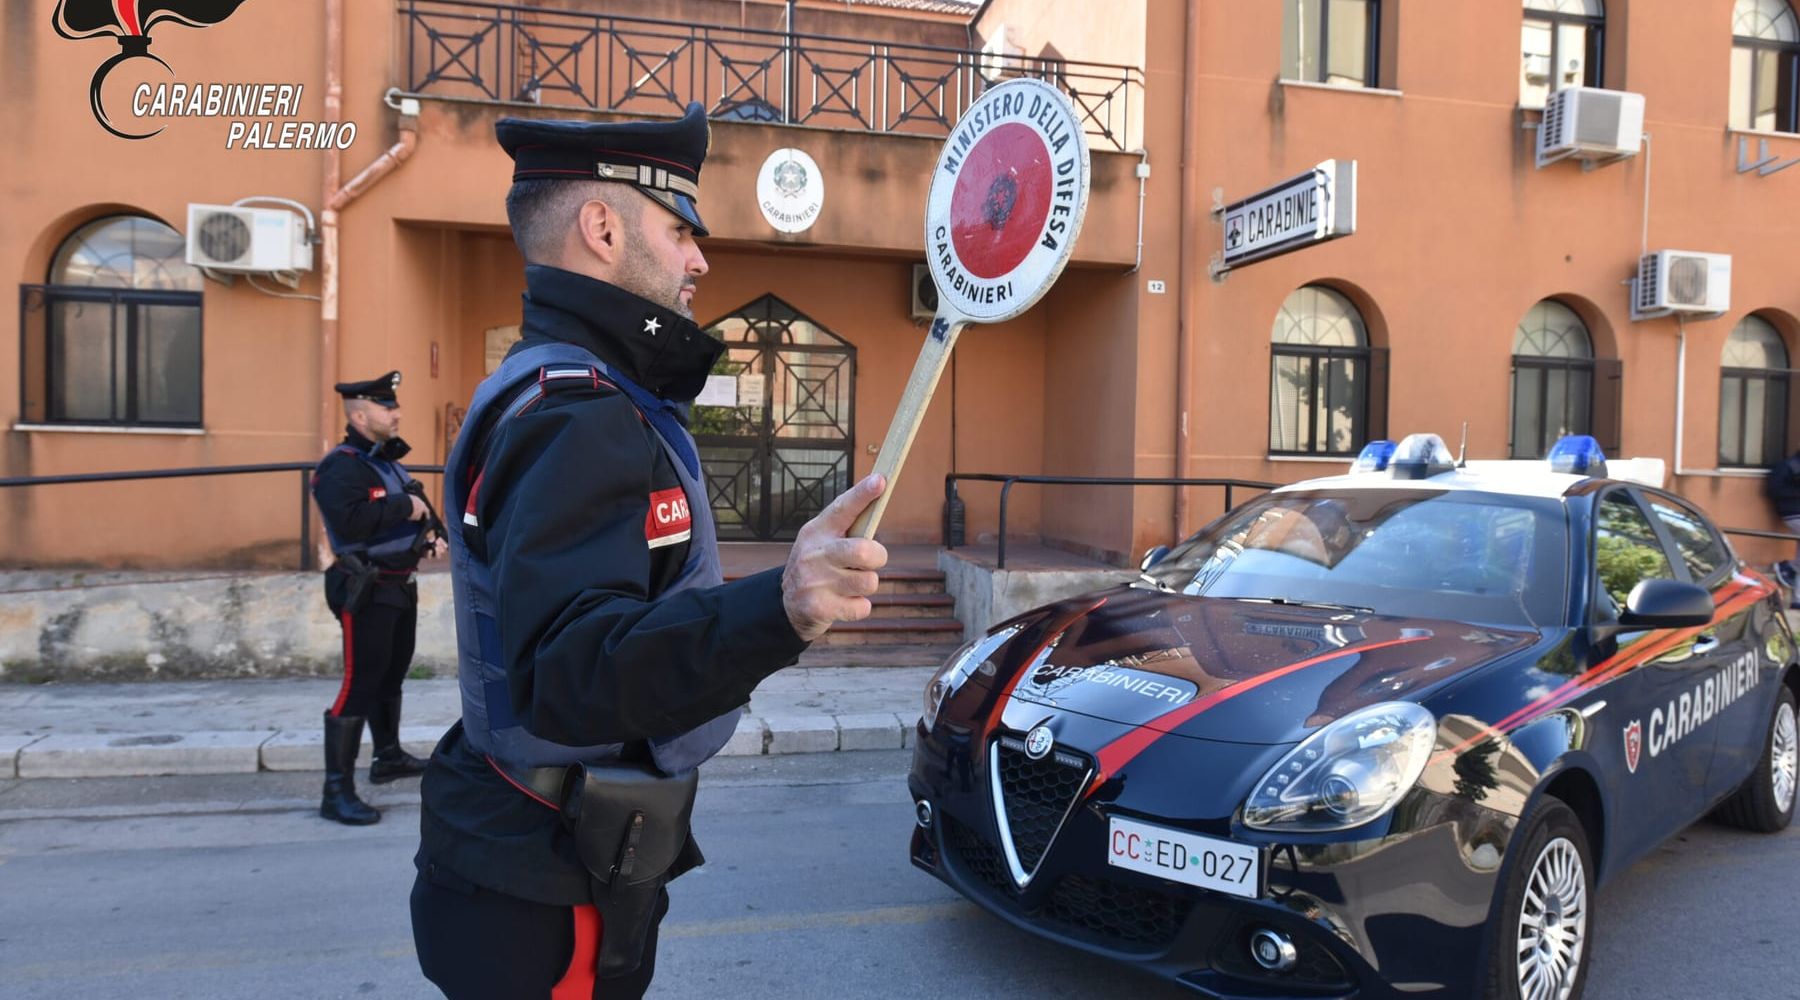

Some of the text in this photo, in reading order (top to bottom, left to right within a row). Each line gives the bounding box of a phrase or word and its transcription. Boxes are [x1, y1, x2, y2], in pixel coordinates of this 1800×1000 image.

[944, 91, 1075, 251] MINISTERO DELLA DIFESA
[762, 200, 819, 225] CARABINIERI
[935, 226, 1013, 304] CARABINIERI
[1151, 282, 1162, 291] 12
[1033, 664, 1191, 704] CARABINIERI
[1649, 647, 1759, 757] CARABINIERI
[1112, 830, 1253, 884] CC ED 027
